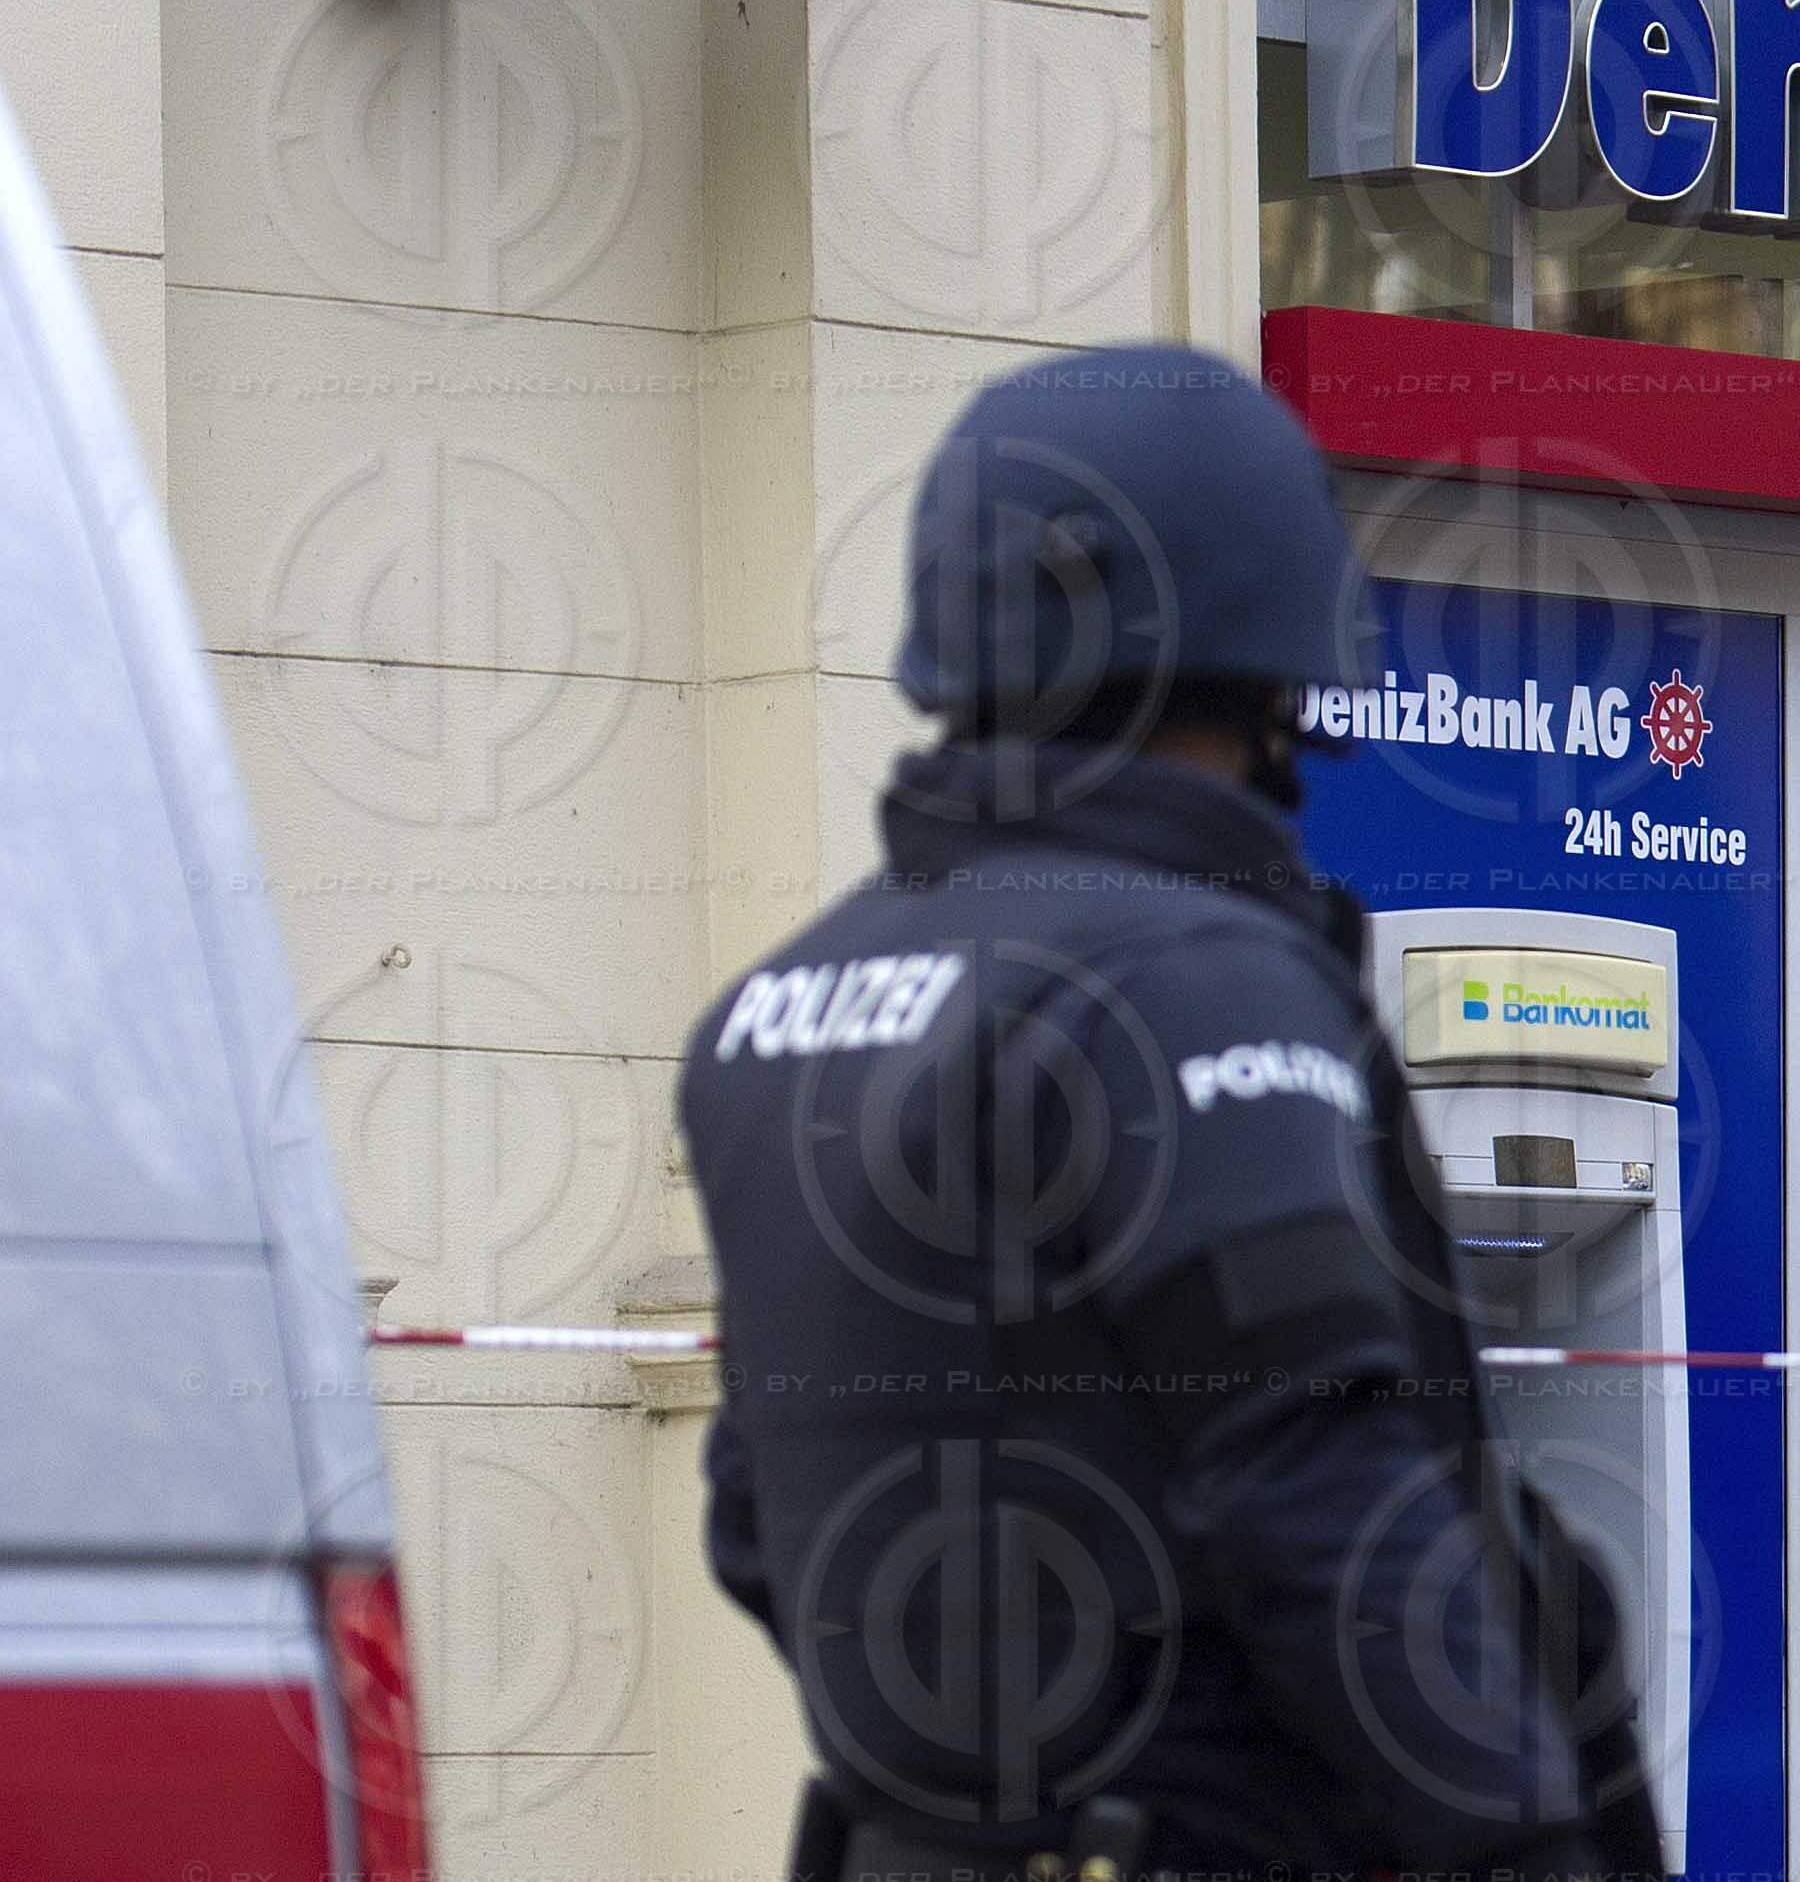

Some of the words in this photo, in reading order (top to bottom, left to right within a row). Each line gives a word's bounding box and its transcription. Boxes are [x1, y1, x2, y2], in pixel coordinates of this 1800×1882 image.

[1564, 685, 1631, 759] AG
[1565, 808, 1622, 856] 24h
[1632, 811, 1747, 866] Service
[715, 953, 968, 1062] POLIZEI
[1504, 983, 1649, 1030] Bankomat
